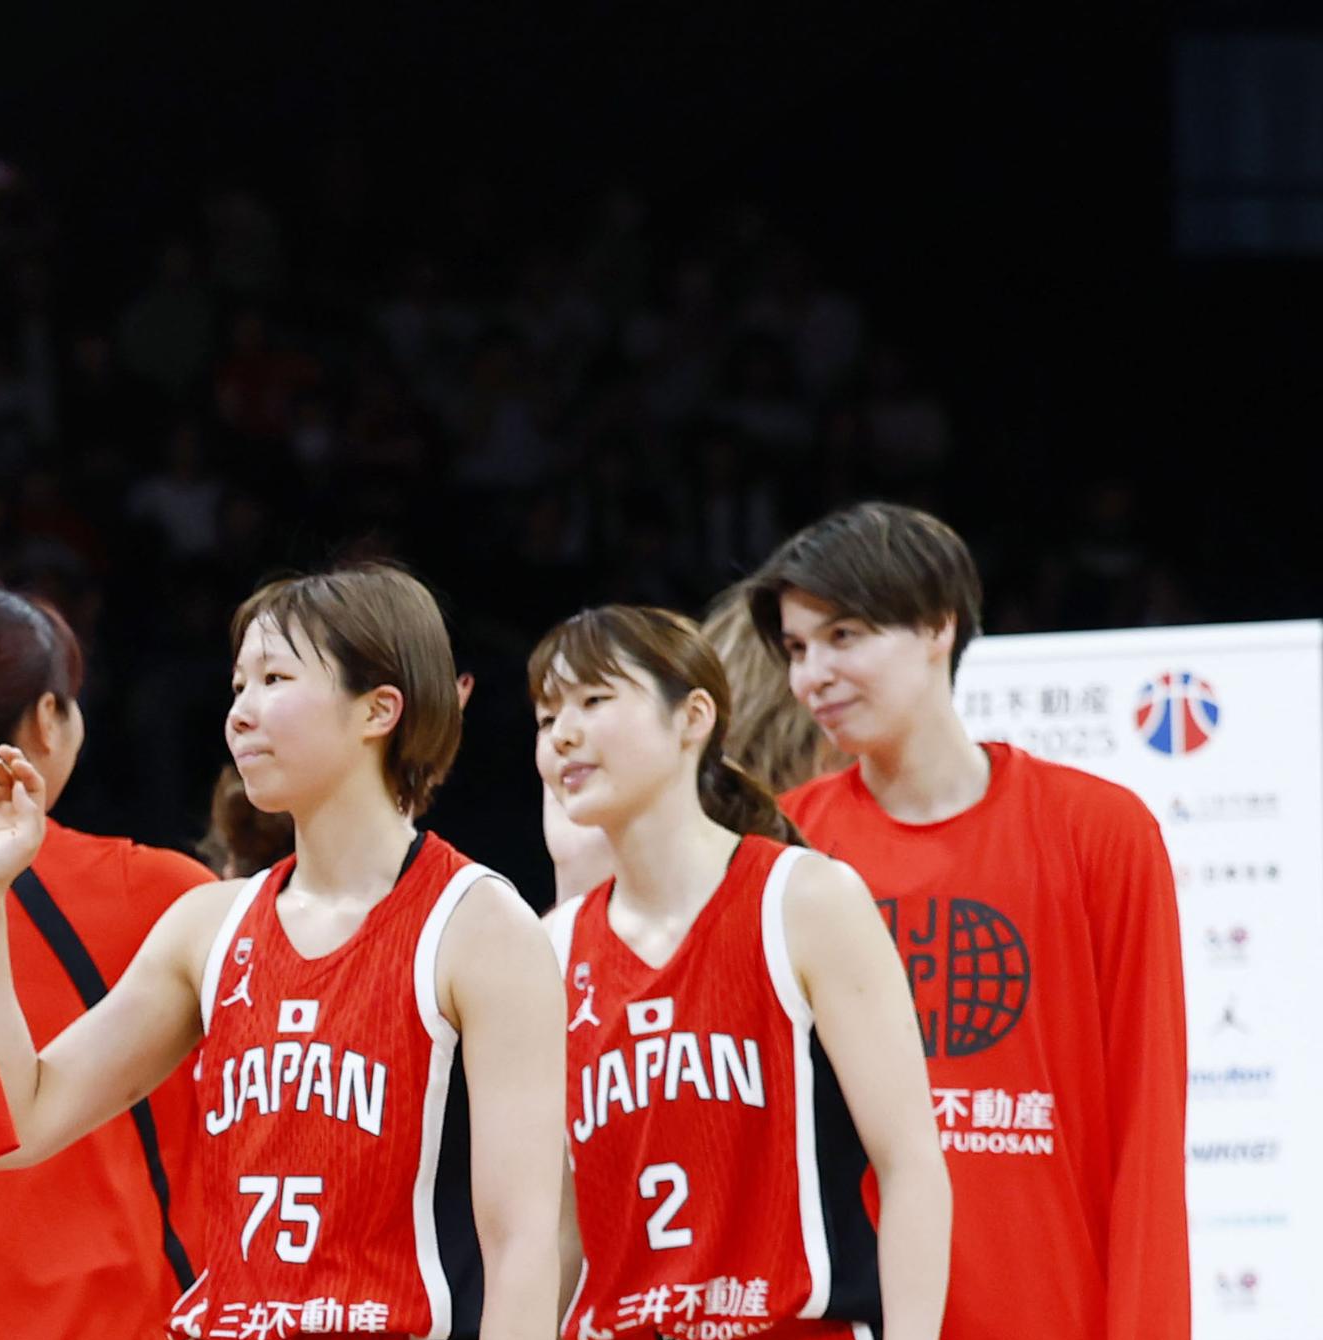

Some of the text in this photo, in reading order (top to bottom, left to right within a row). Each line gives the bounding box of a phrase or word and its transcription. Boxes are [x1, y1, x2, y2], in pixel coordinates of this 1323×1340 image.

[204, 1041, 387, 1137] JAPAN
[573, 1031, 766, 1144] JAPAN
[930, 1089, 1054, 1130] 不動産
[940, 1132, 1054, 1155] FUDOSAN
[238, 1176, 323, 1264] 75
[638, 1162, 693, 1250] 2
[614, 1275, 770, 1332] 三井不動産
